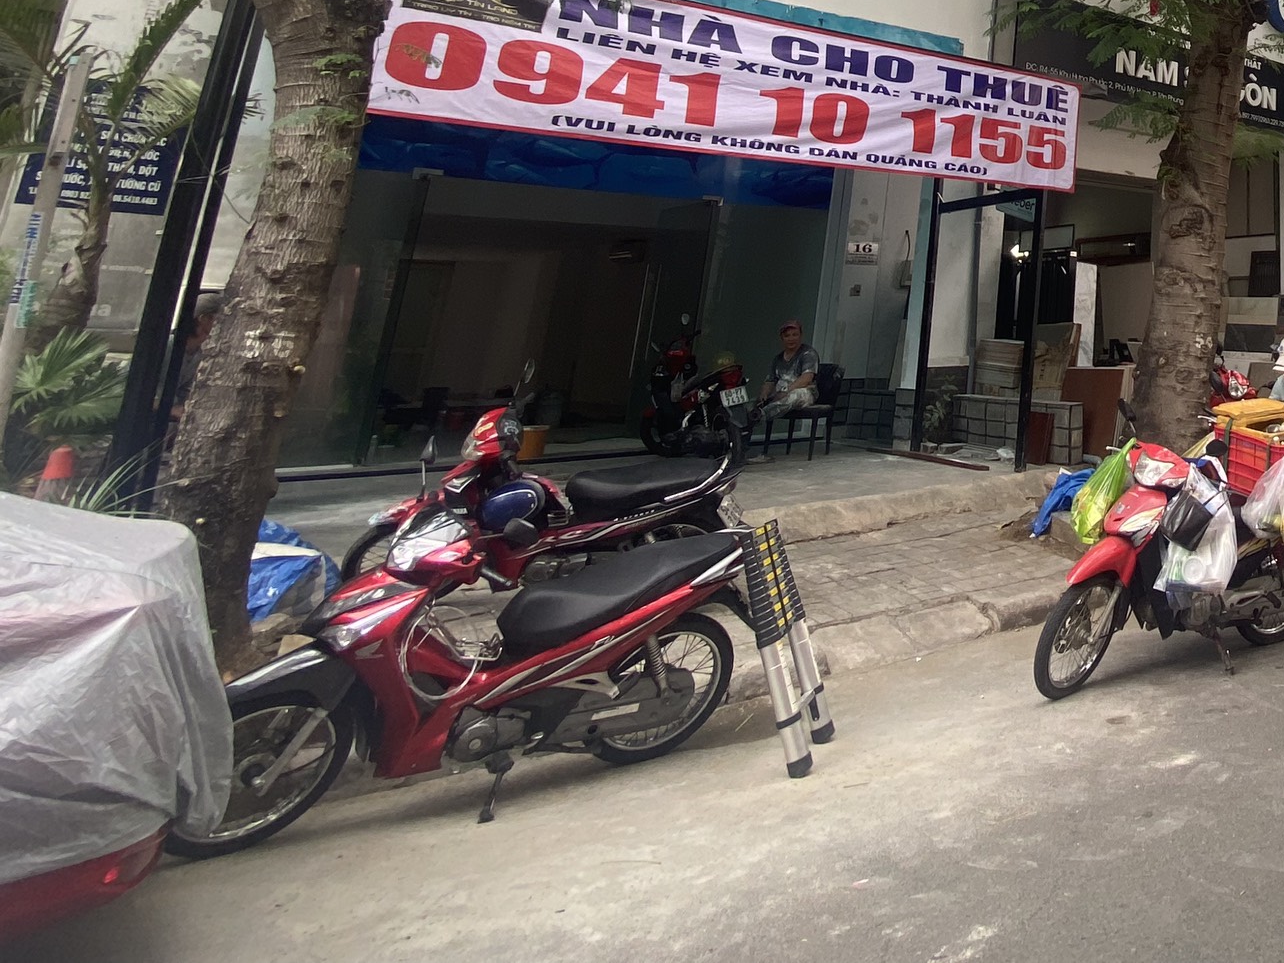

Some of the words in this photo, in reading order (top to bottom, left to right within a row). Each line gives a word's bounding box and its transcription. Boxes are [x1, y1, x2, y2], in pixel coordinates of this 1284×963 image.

[487, 5, 519, 16] LAND
[556, 26, 657, 56] LIÊN
[670, 48, 723, 68] HỆ
[733, 59, 814, 84] XEM
[825, 76, 900, 98] NHÀ:
[910, 90, 999, 114] THÀNH
[1007, 106, 1067, 126] LUÂN
[771, 35, 915, 84] CHO
[937, 64, 1070, 113] THUÊ
[1115, 48, 1179, 87] NAM
[1239, 73, 1277, 112] ÒN
[384, 20, 722, 128] 0941
[758, 86, 870, 145] 10
[900, 108, 1067, 170] 1155
[550, 114, 616, 132] (VUI
[625, 124, 702, 143] LÒNG
[711, 135, 801, 155] KHÔNG
[808, 146, 857, 161] DÁN
[865, 151, 938, 170] QUẢNG
[943, 162, 989, 176] CÁO)
[853, 243, 873, 254] 16
